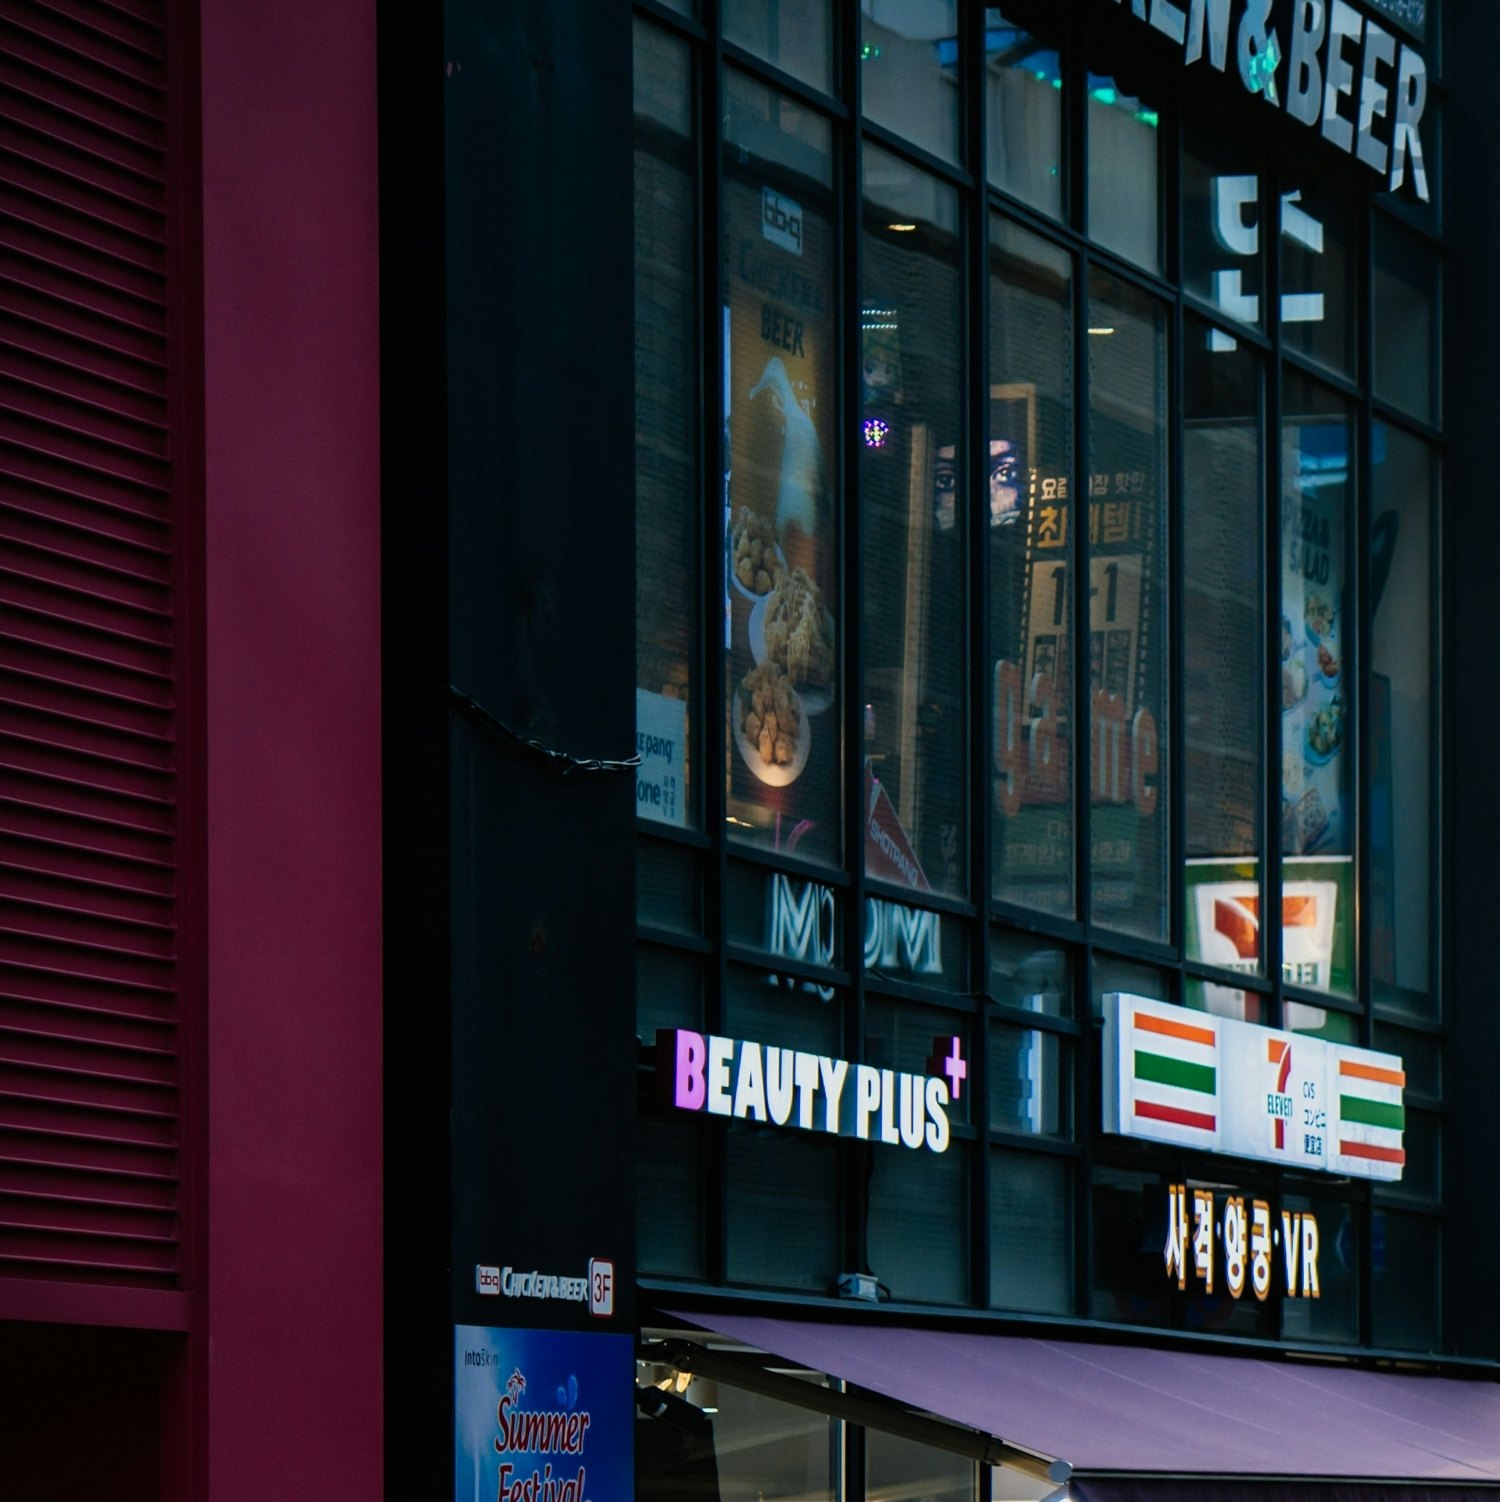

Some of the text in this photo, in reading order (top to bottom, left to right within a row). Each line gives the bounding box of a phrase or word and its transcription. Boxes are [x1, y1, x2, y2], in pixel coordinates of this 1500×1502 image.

[675, 1028, 848, 1134] BEAUTY
[1302, 1080, 1316, 1100] CVS
[1304, 1109, 1327, 1129] コンビニ
[1303, 1134, 1323, 1157] 便宜店
[593, 1272, 611, 1305] 3F
[495, 1396, 590, 1456] Summer
